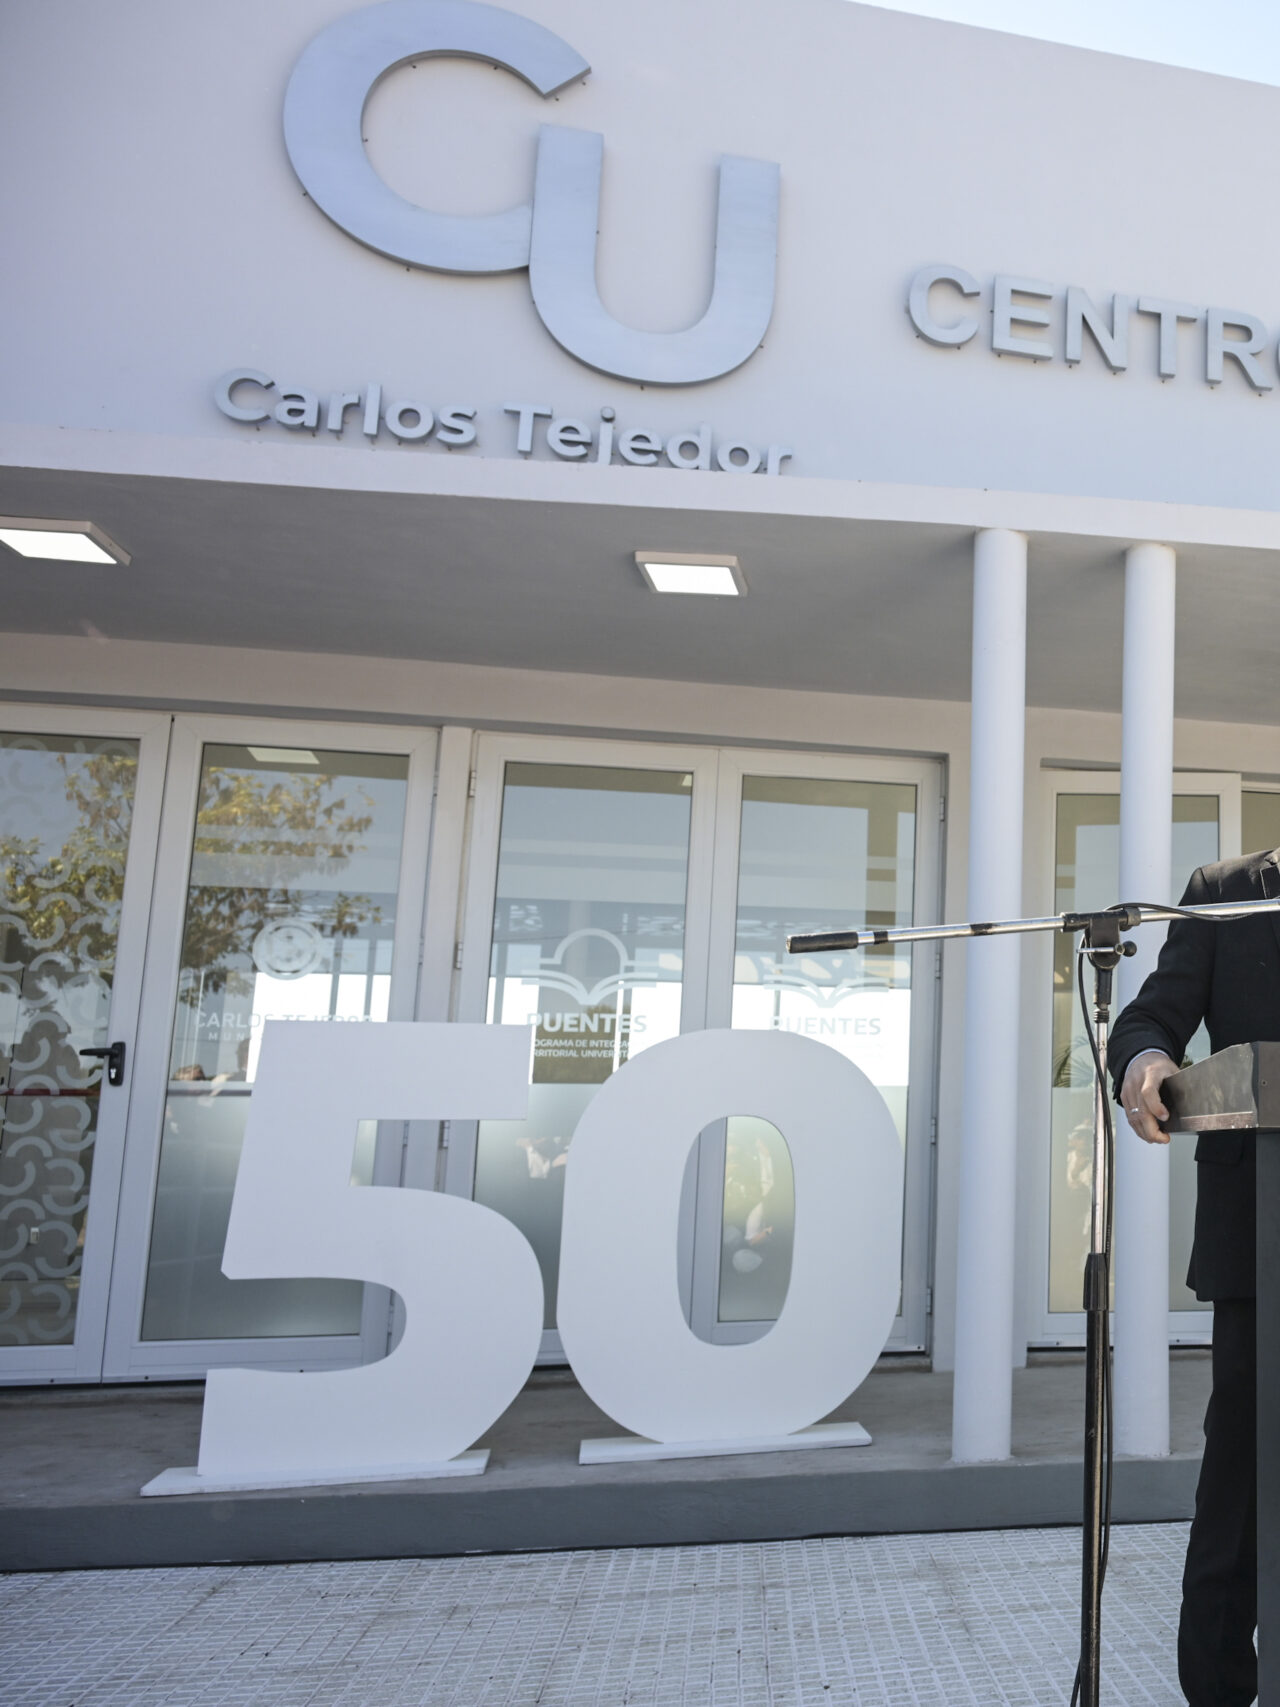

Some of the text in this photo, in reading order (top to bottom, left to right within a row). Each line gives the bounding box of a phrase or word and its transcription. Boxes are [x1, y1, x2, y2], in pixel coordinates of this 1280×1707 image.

[283, 0, 781, 388] CU
[214, 367, 793, 475] Carlos Tejedor
[527, 1013, 647, 1033] PUENTES
[533, 1039, 574, 1048] OGRAMA
[575, 1040, 587, 1048] DE
[770, 1016, 881, 1036] PUENTES
[198, 1020, 903, 1476] 50
